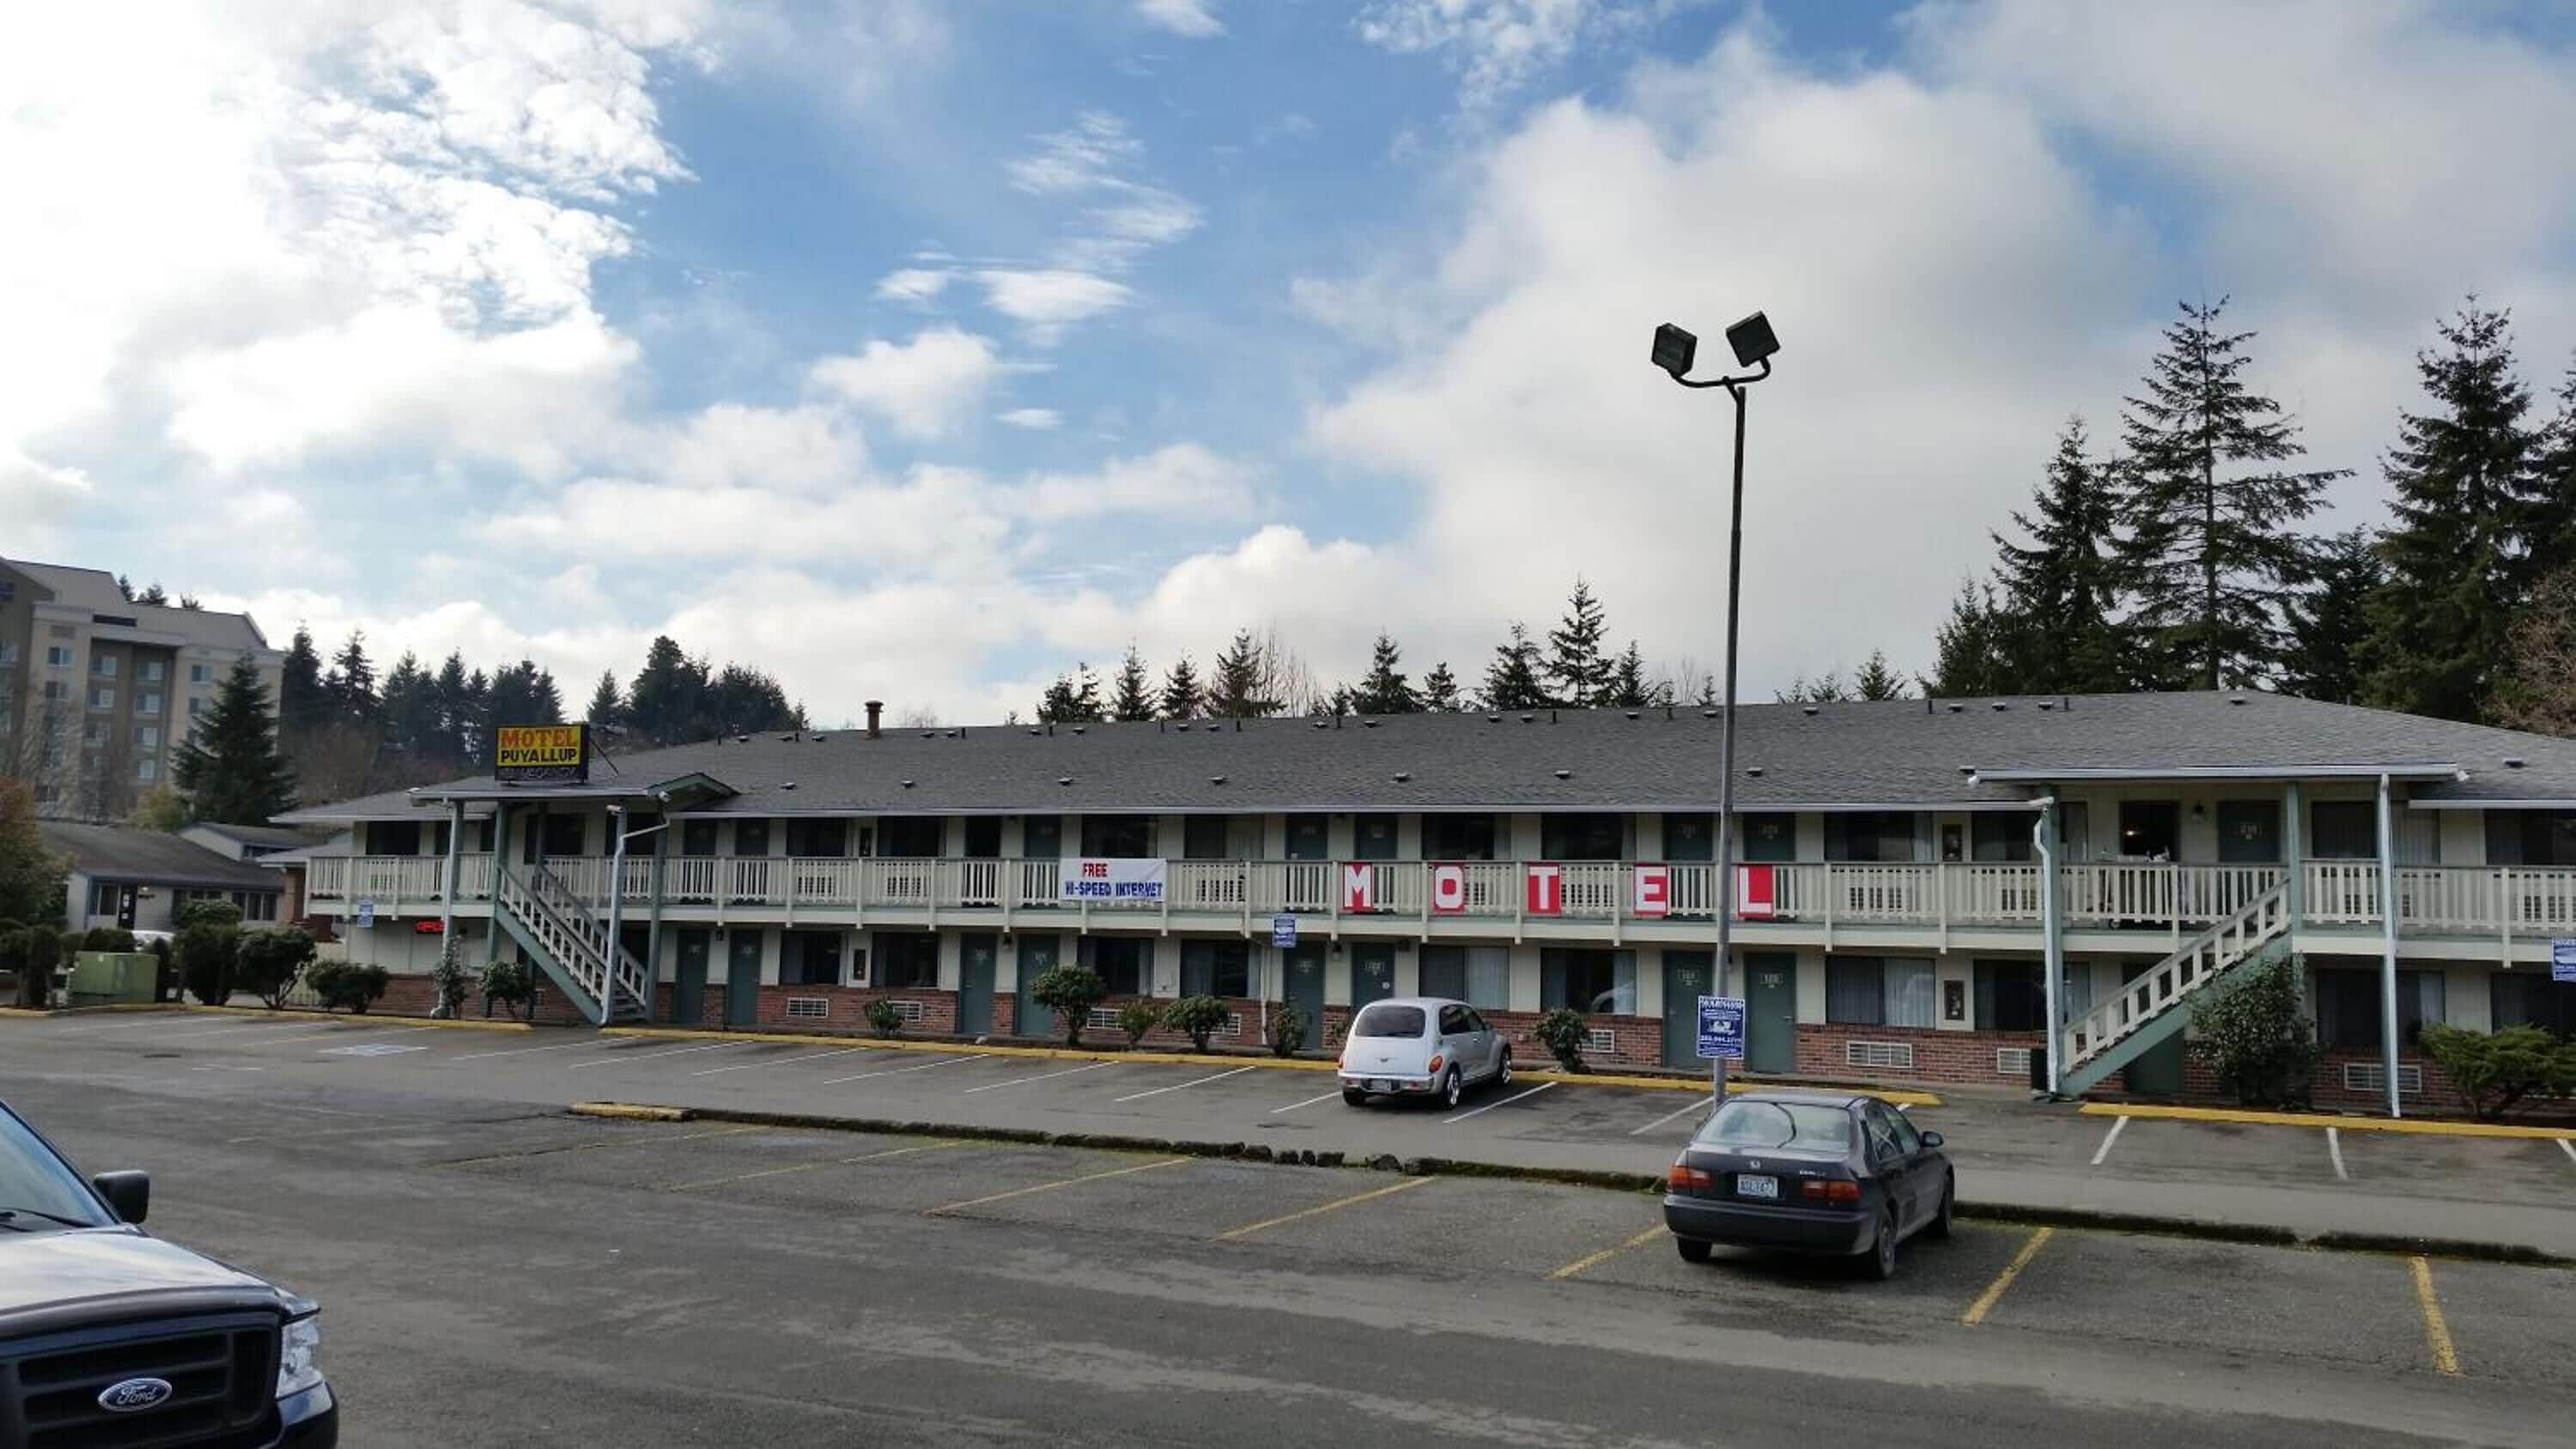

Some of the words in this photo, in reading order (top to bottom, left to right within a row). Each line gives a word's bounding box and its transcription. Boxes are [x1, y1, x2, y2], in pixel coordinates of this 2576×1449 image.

[501, 729, 578, 748] MOTEL
[501, 748, 577, 763] PUYALLUP
[1083, 863, 1108, 877] FREE
[1066, 881, 1112, 895] HI-SPEED
[1115, 882, 1163, 896] INTERNET
[116, 1385, 158, 1405] Ford
